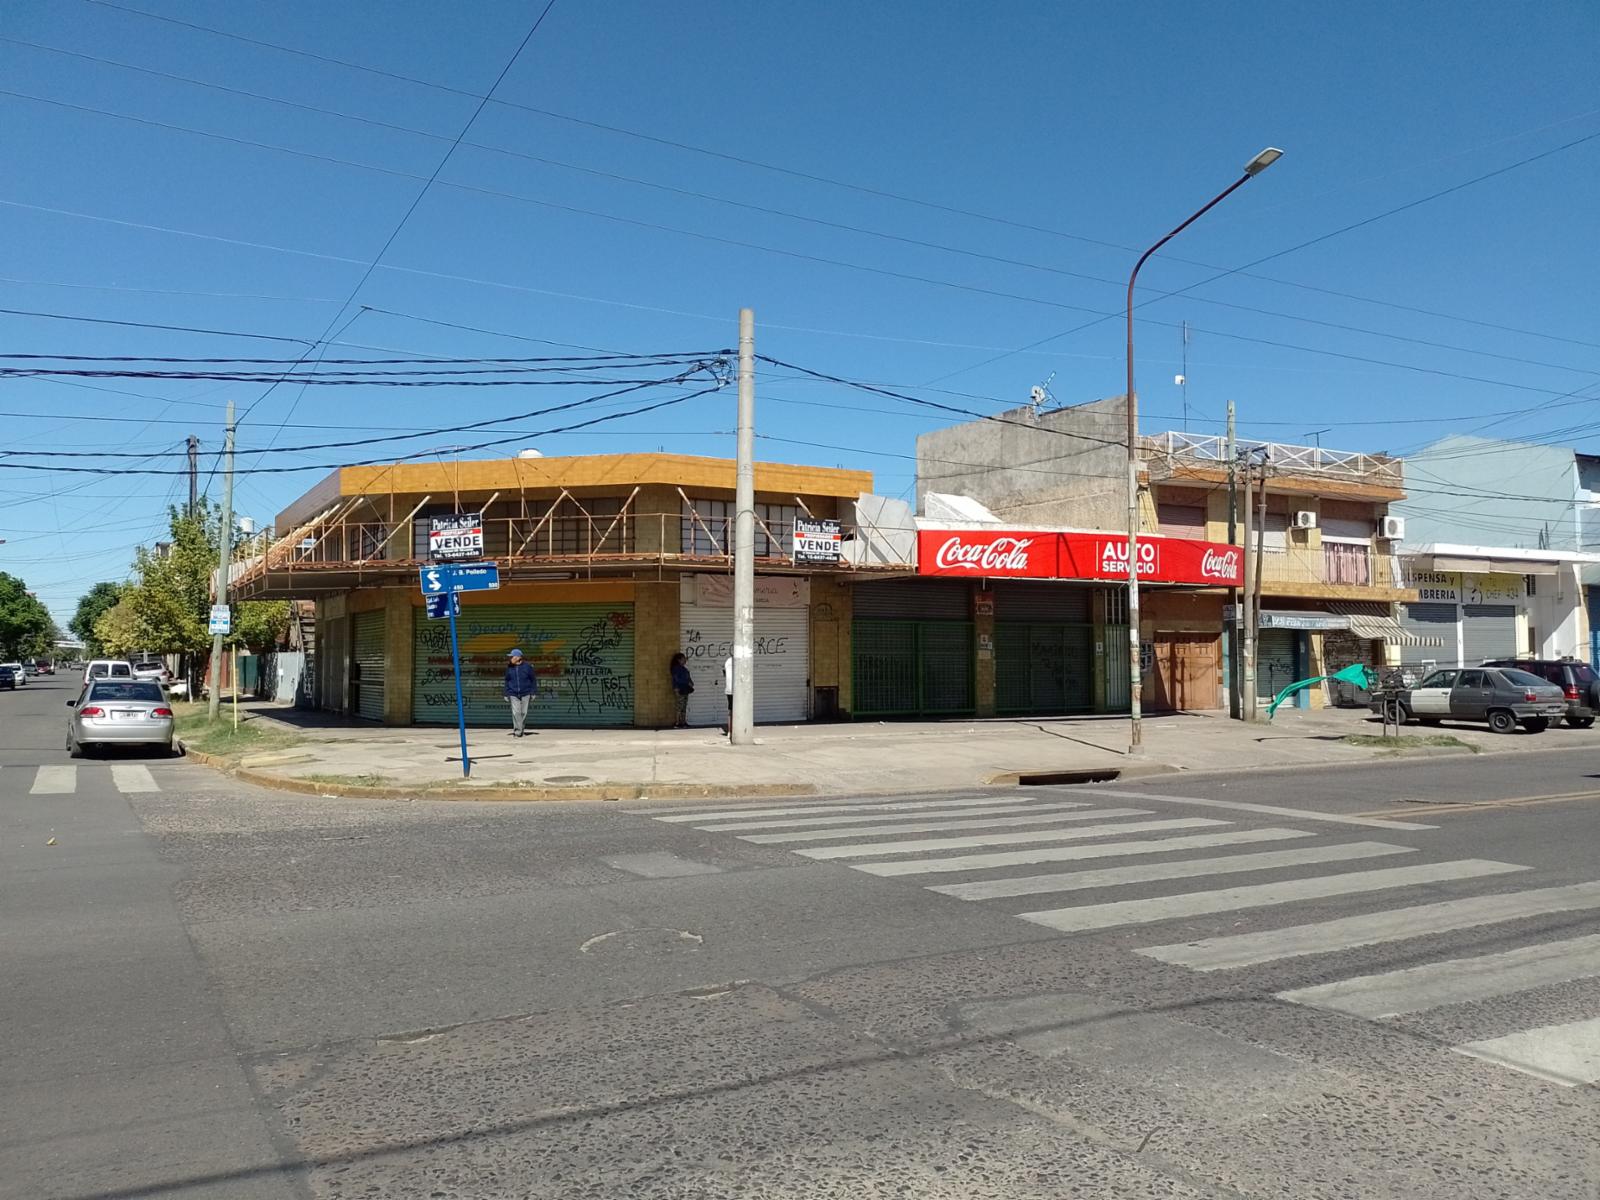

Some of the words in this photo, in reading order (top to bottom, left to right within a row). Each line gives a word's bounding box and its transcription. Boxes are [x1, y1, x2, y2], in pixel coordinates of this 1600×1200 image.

[432, 518, 459, 530] Patricia
[459, 516, 479, 529] Seiler
[797, 519, 820, 532] Patricia
[821, 521, 839, 533] Seiler
[435, 536, 480, 549] VENDE
[799, 539, 839, 551] VENDE
[936, 536, 1033, 570] Coca-Cola
[1102, 560, 1154, 574] SERVCIO
